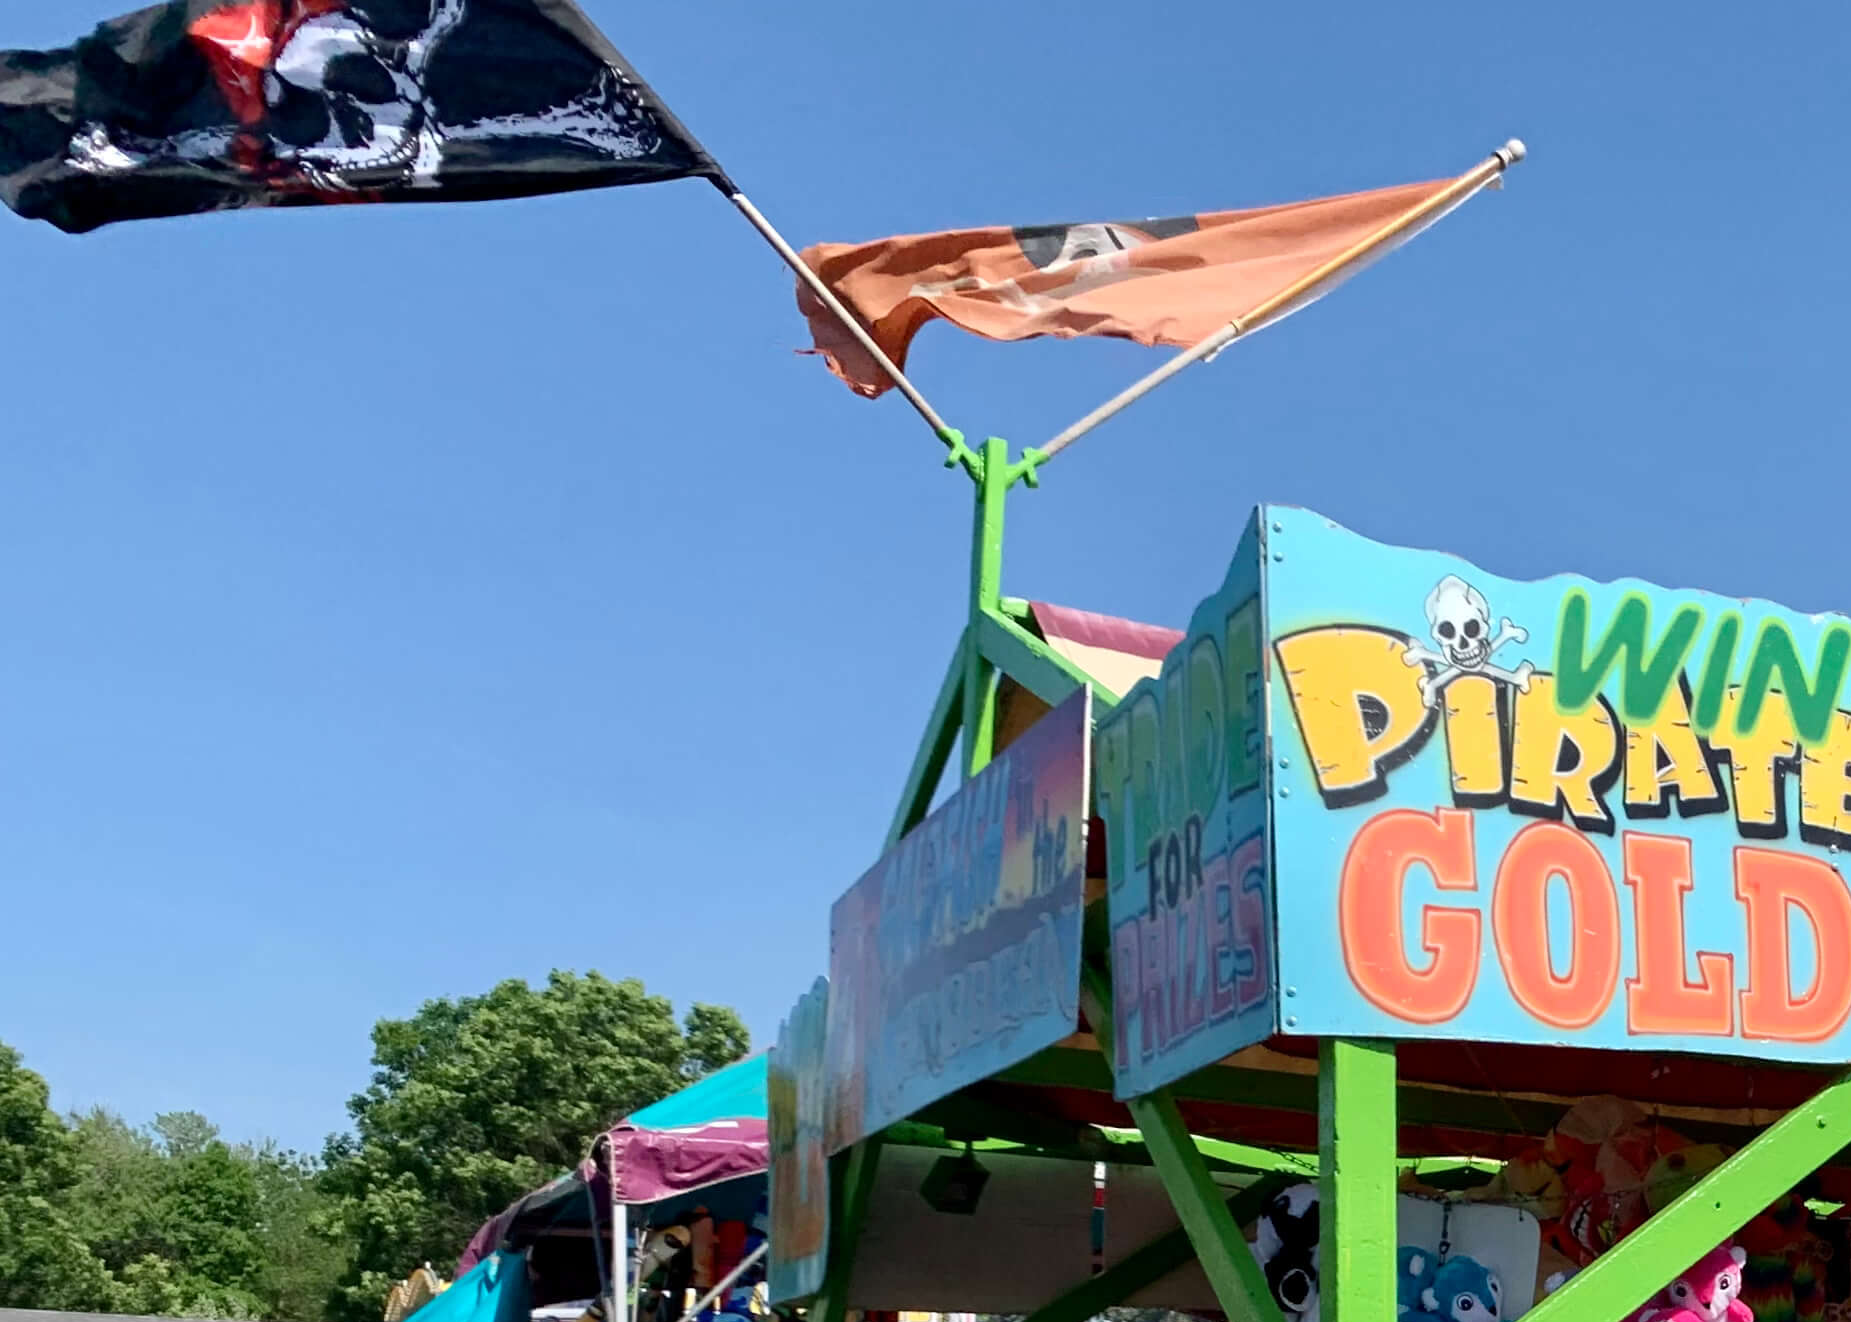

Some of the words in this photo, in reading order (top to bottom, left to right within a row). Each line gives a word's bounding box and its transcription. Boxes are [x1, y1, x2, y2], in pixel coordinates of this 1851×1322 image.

[1100, 593, 1262, 894] TRADE
[1147, 813, 1204, 921] FOR
[1112, 826, 1270, 1074] PRIZES
